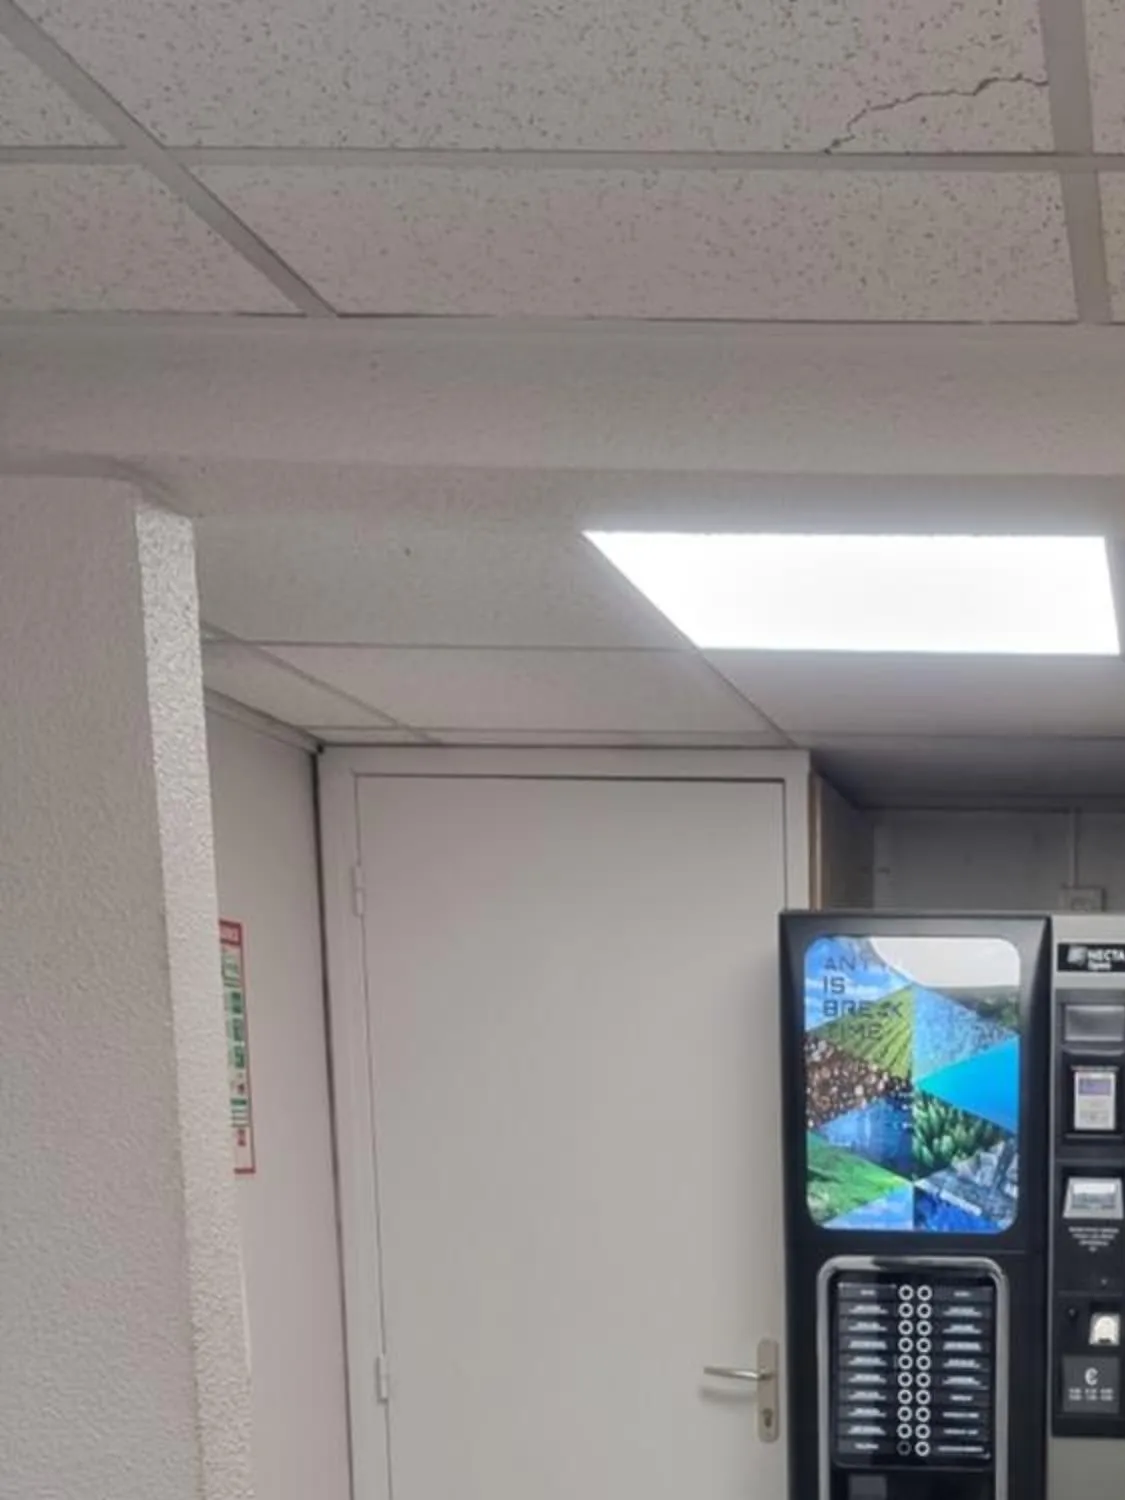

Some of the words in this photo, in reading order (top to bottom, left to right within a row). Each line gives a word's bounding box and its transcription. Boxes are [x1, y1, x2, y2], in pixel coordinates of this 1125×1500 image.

[1087, 948, 1125, 962] NECTA
[823, 975, 845, 994] IS
[823, 999, 903, 1019] BREAK
